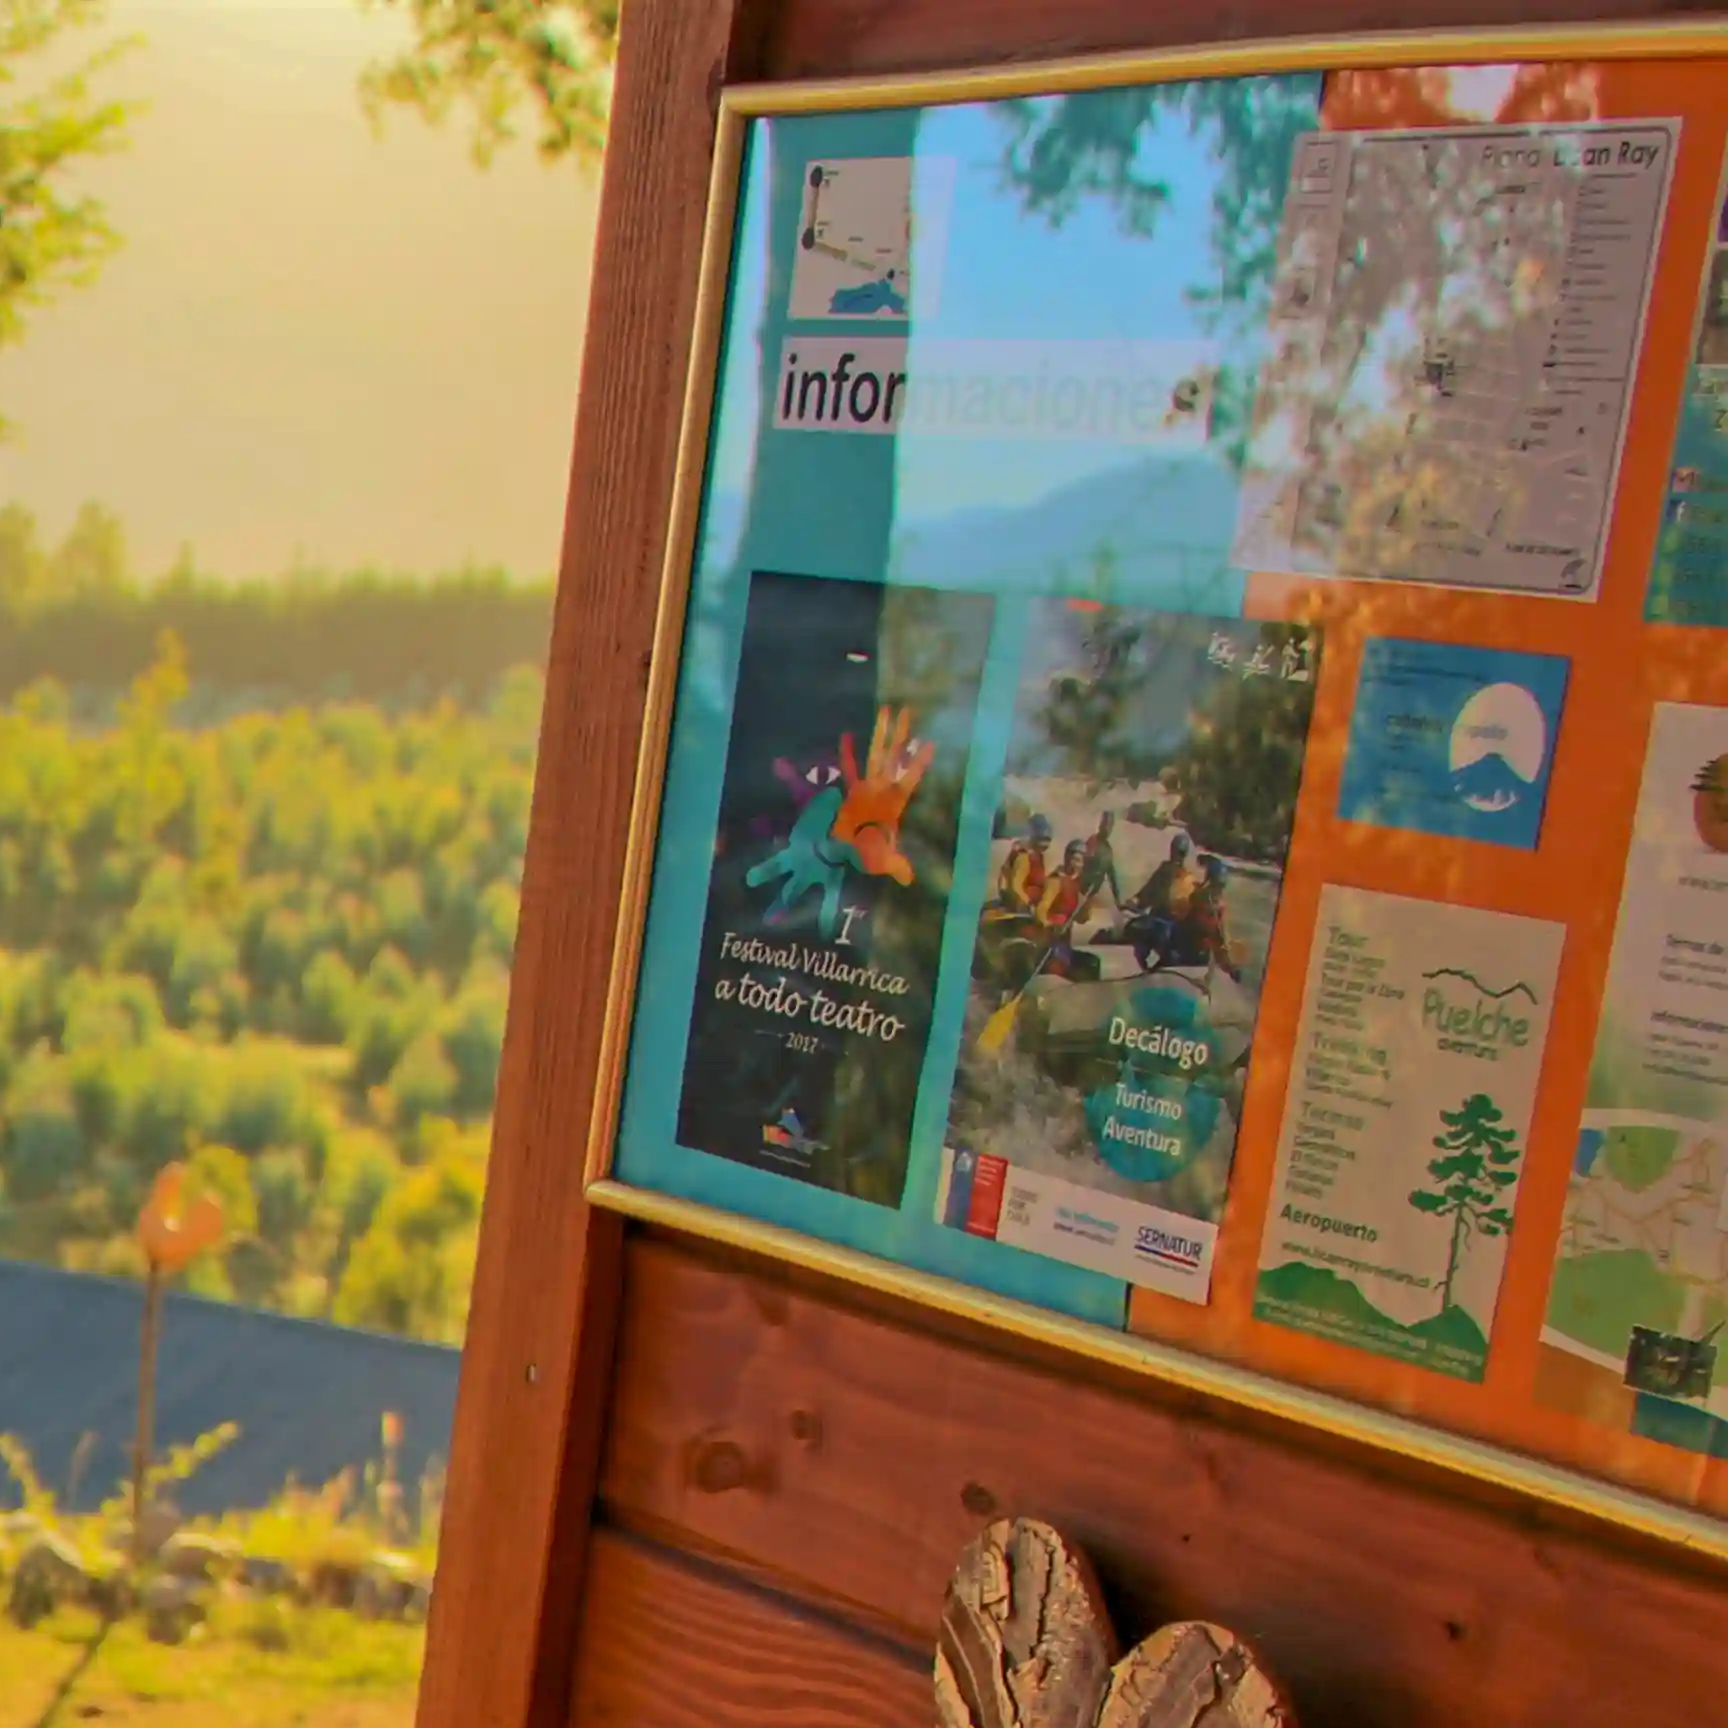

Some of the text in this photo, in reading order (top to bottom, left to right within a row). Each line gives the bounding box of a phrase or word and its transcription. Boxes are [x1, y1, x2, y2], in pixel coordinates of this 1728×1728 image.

[1616, 140, 1661, 170] Ray
[720, 931, 910, 996] Festival Villarrica
[714, 971, 907, 1042] a todo teatro
[1421, 987, 1530, 1047] Puelche
[784, 1031, 819, 1054] 2017
[1108, 1016, 1209, 1070] Decálogo
[1115, 1082, 1183, 1121] Turismo
[1102, 1115, 1182, 1157] Aventura
[1136, 1224, 1204, 1262] SERNATUR
[1279, 1203, 1379, 1244] Aeropuerto
